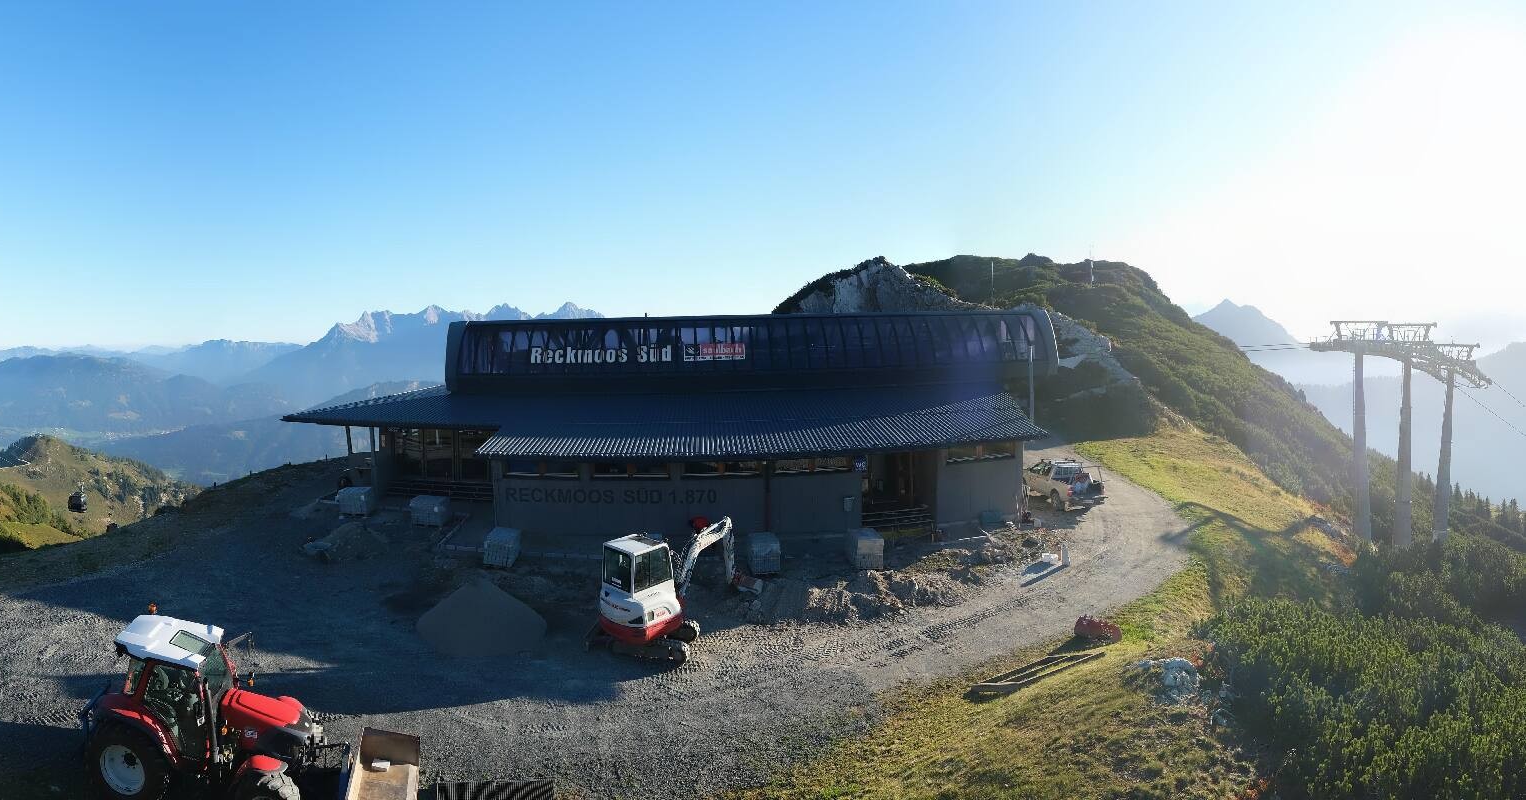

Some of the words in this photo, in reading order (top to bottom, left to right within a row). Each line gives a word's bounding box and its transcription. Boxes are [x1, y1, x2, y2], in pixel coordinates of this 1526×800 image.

[530, 346, 628, 364] Reckmoos
[636, 344, 672, 363] Süd
[504, 487, 614, 505] RECKMOOS
[623, 486, 664, 505] SÜD
[667, 488, 717, 505] 1.870
